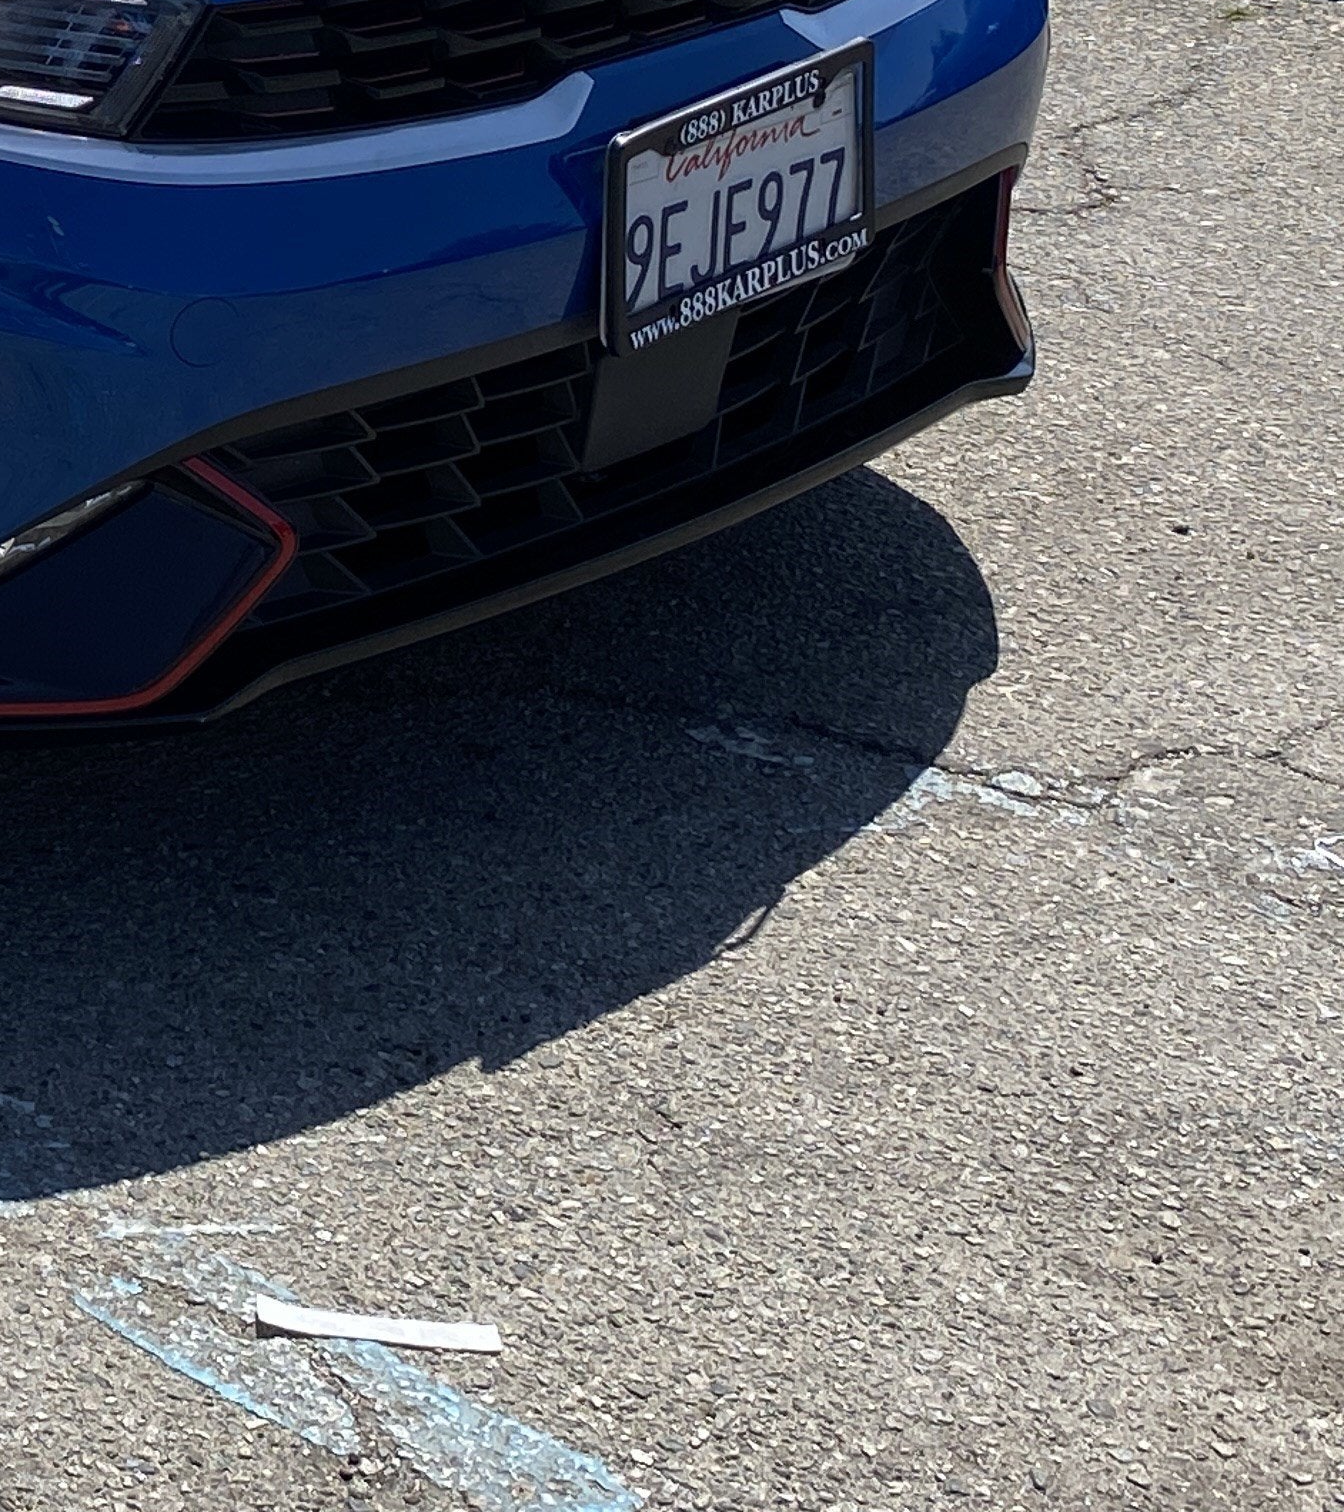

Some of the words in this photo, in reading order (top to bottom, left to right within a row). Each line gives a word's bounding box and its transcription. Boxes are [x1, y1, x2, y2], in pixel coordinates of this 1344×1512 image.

[666, 115, 820, 183] California
[680, 109, 726, 145] (888)
[732, 70, 820, 127] KARPLUS
[627, 147, 846, 311] 9EJE977
[629, 229, 868, 350] www.888KARPLUS.COM
